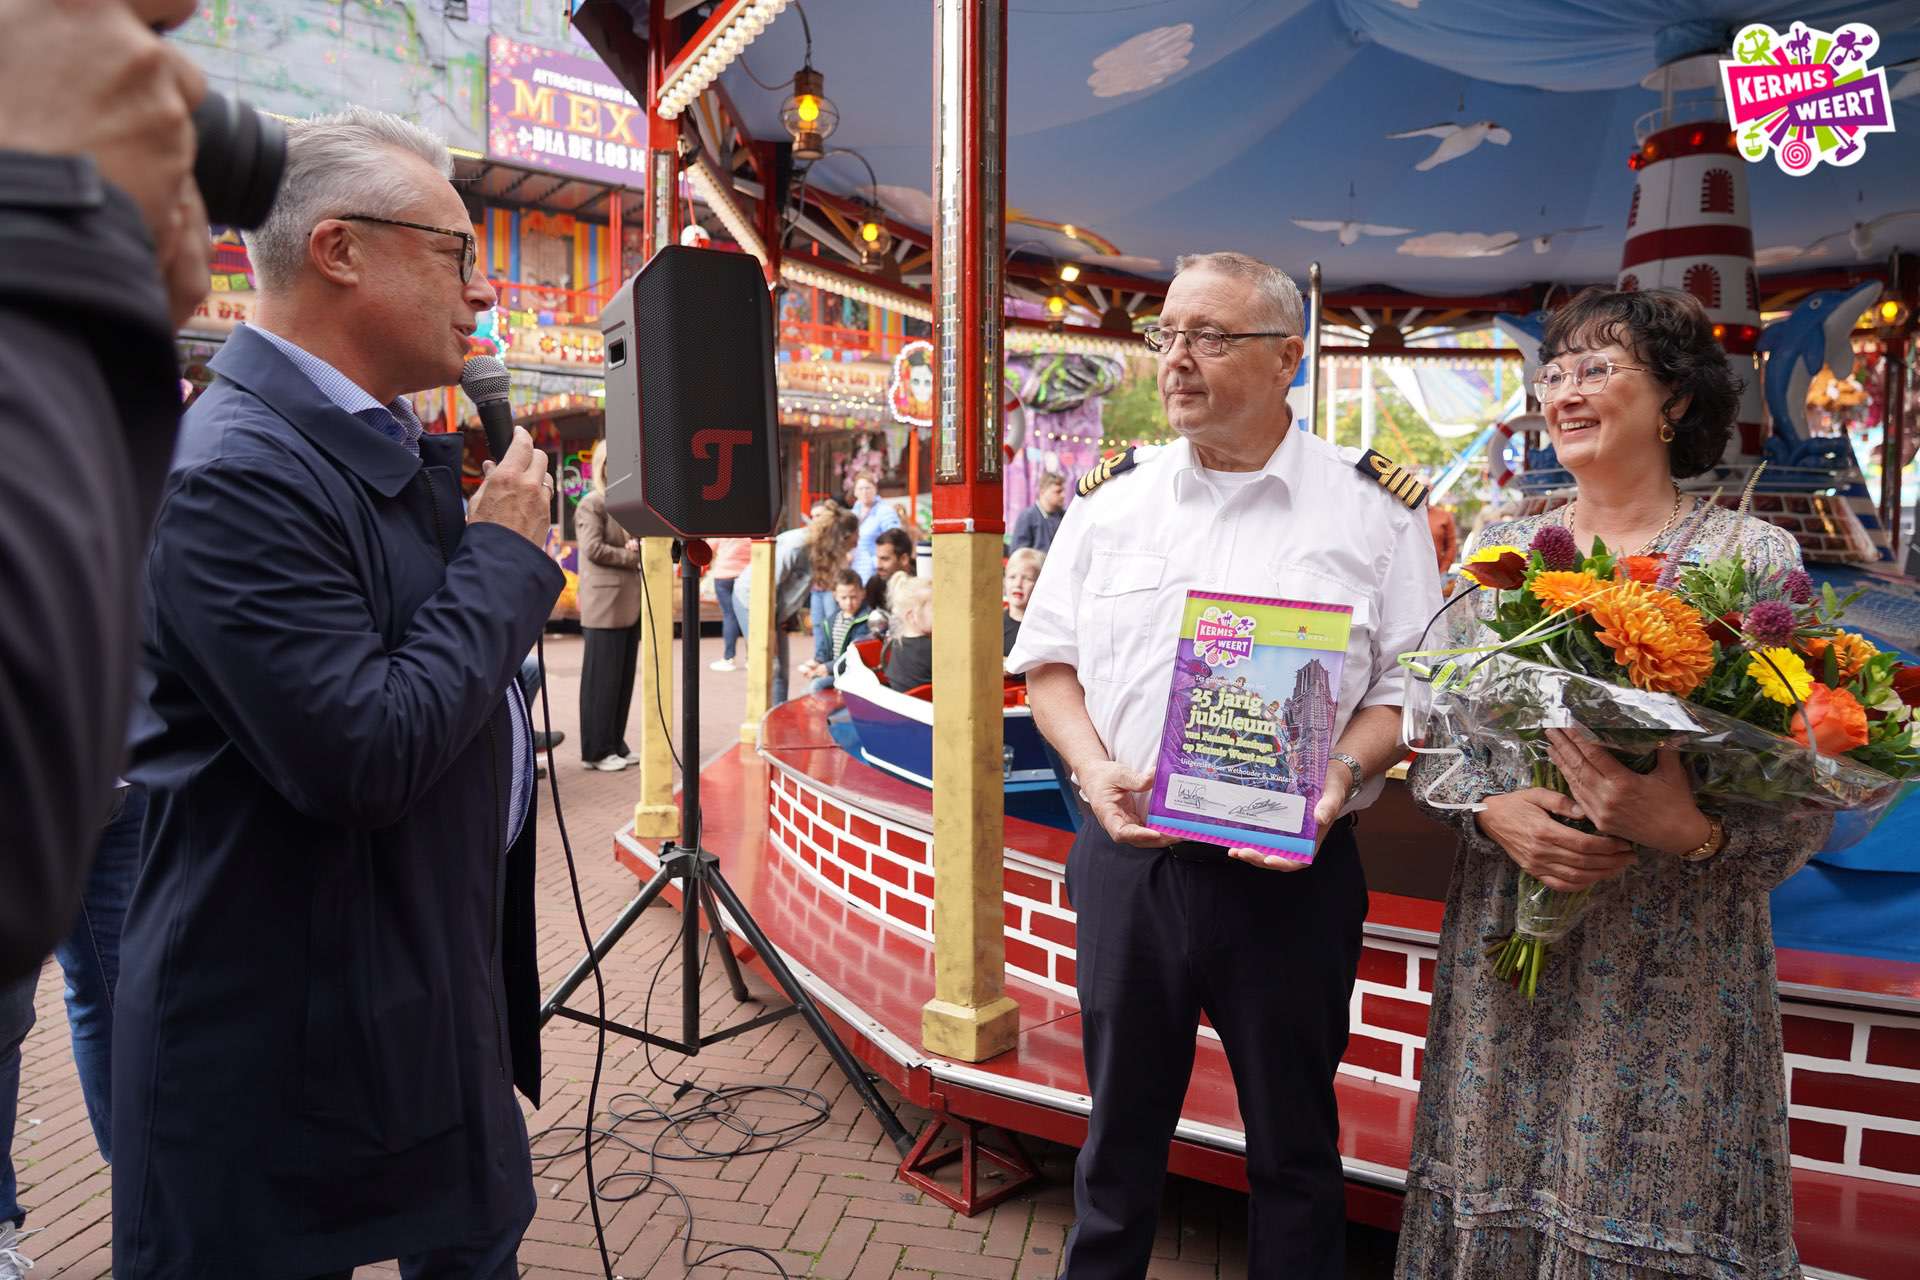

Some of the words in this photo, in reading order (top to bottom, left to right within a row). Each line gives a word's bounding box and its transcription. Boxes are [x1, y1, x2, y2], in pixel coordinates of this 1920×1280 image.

[532, 68, 593, 96] ATTRACTIE
[568, 134, 593, 162] DE
[595, 140, 629, 169] LOS
[1199, 624, 1235, 638] KERMIS
[1217, 639, 1249, 653] WEERT
[1190, 687, 1213, 708] 25
[1214, 687, 1264, 717] jarig
[1185, 704, 1277, 736] jubileum
[1182, 743, 1195, 754] op
[1195, 743, 1228, 757] Kermis
[1228, 748, 1256, 762] Weert
[1227, 766, 1261, 778] Wethouder
